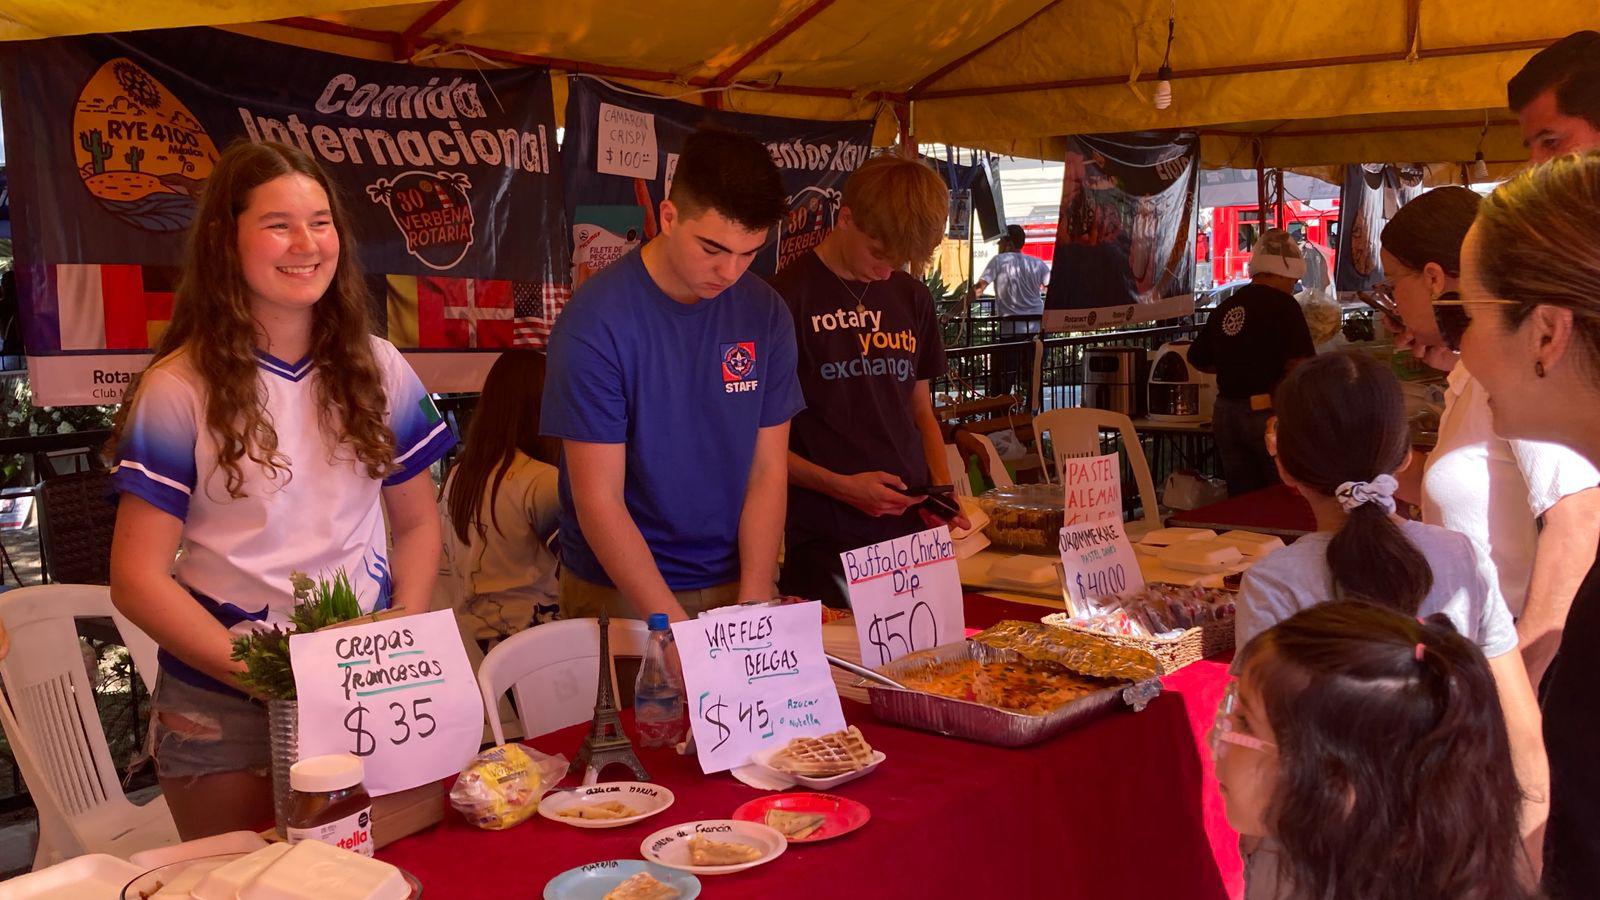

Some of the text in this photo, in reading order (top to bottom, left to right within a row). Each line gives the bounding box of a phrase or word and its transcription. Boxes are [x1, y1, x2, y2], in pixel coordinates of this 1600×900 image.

[604, 109, 648, 130] CAMARON
[107, 119, 199, 148] RYE 4100
[238, 107, 550, 174] Internacional
[610, 129, 647, 146] CRISPY
[766, 138, 832, 171] entos
[396, 190, 423, 213] 30
[399, 208, 470, 231] VERBENA
[788, 206, 807, 234] 30
[409, 228, 470, 248] ROTARIA
[590, 246, 612, 254] FILETE
[590, 253, 622, 261] PESCADO
[811, 308, 882, 333] rotary
[858, 329, 917, 356] youth
[92, 387, 117, 398] Club
[725, 380, 758, 393] STAFF
[1069, 459, 1113, 486] PASTEL
[845, 530, 954, 581] Buffalo Chicken
[892, 569, 920, 598] Dip
[705, 615, 772, 652] WAFFLES
[744, 649, 798, 677] BELGAS
[343, 698, 436, 757] $ 35
[704, 694, 770, 752] $ 45
[336, 830, 367, 849] tella
